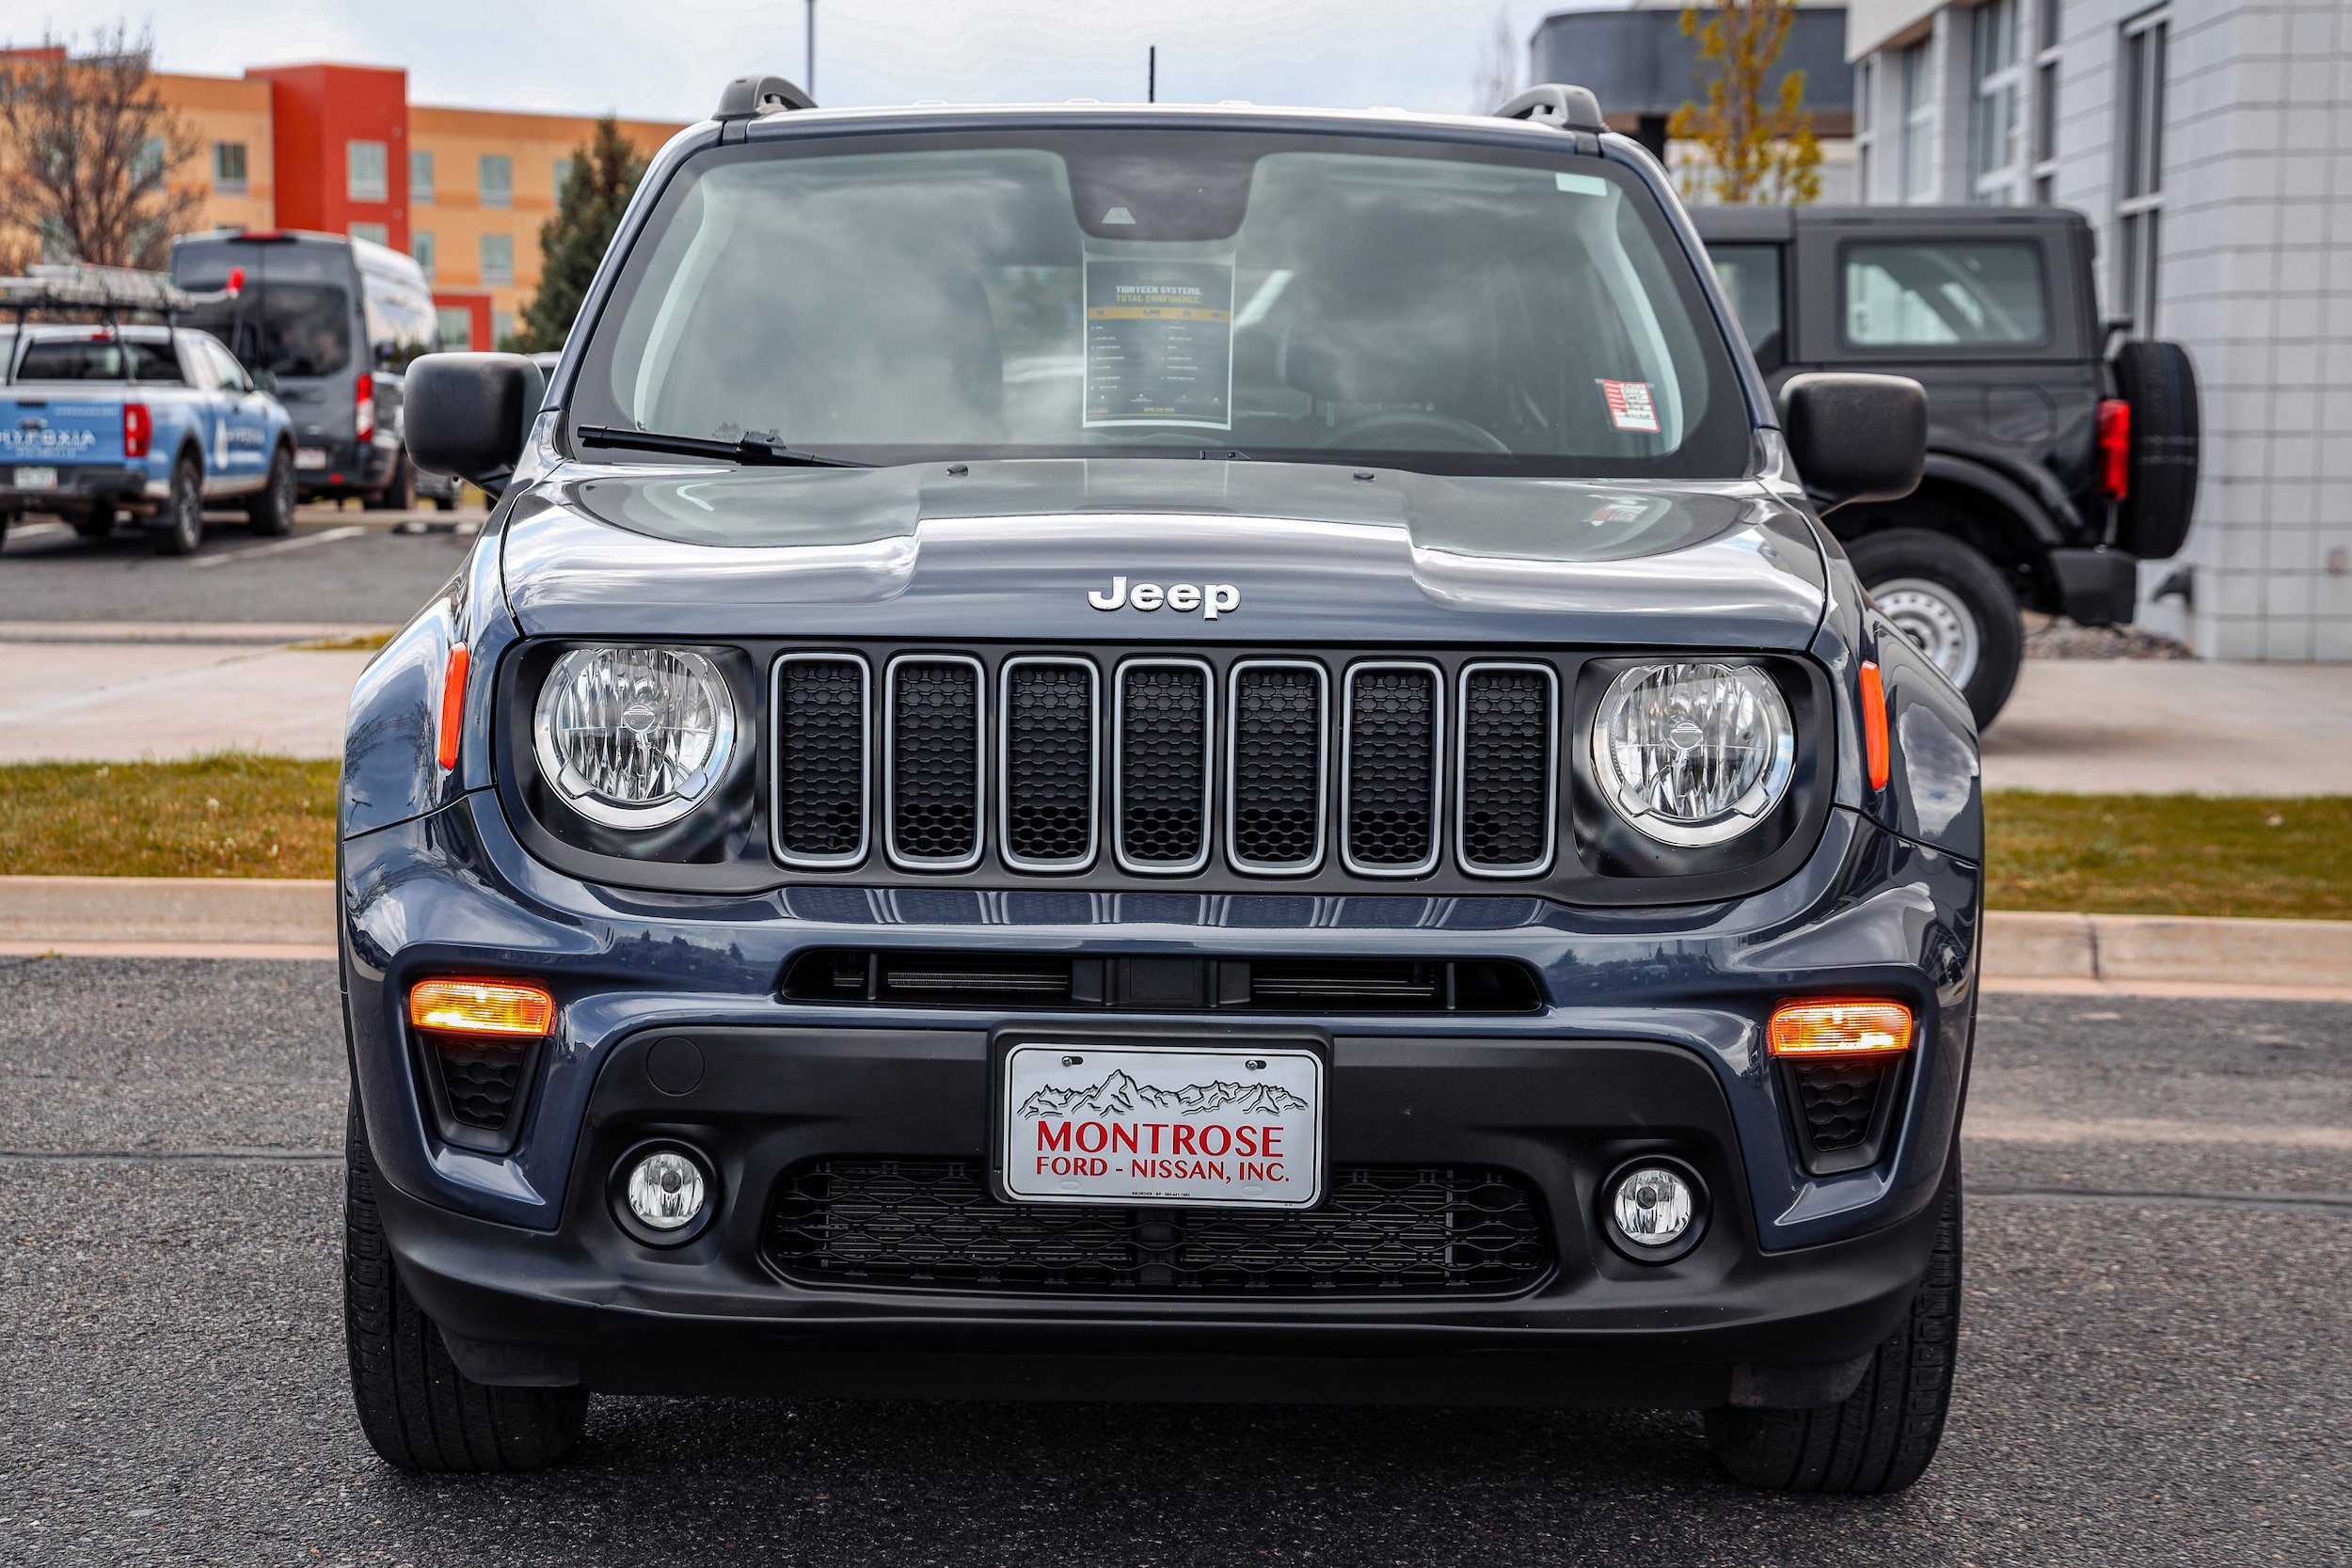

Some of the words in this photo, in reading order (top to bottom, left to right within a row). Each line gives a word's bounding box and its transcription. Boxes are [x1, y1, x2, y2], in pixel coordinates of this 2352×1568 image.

[1088, 576, 1241, 622] Jeep
[1037, 1120, 1284, 1157] MONTROSE
[1036, 1156, 1108, 1177] FORD
[1131, 1159, 1232, 1184] NISSAN,
[1239, 1162, 1290, 1182] INC.
